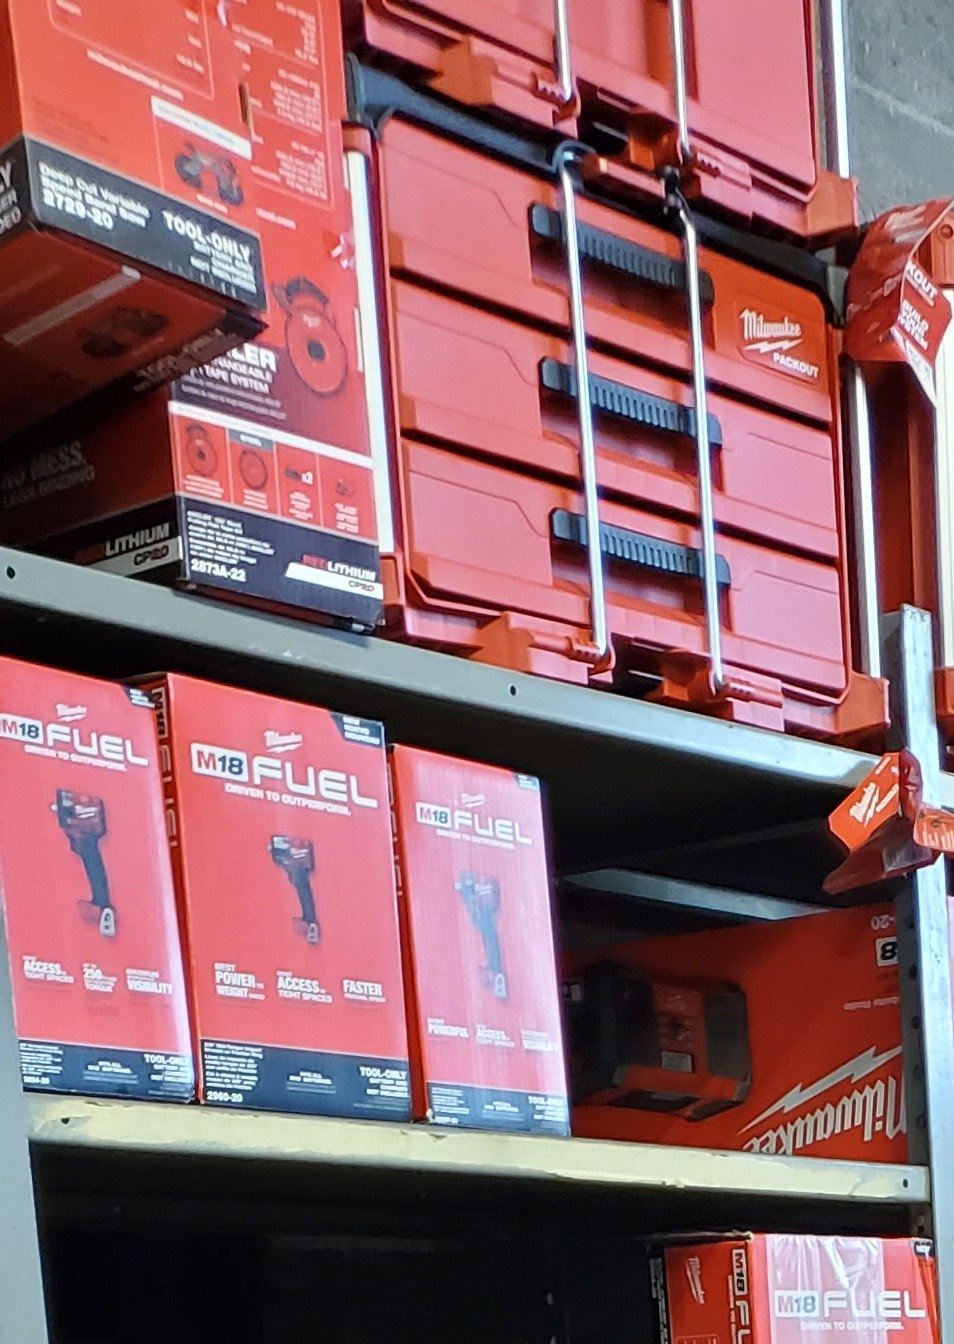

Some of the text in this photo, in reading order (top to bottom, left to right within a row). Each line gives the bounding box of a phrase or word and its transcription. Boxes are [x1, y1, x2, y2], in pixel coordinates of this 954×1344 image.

[38, 160, 74, 188] Deep
[162, 210, 252, 264] TOOL-ONLY
[740, 308, 802, 341] Milwaukee
[773, 352, 820, 379] PACKOUT
[190, 559, 247, 583] 2873A-22
[3, 719, 149, 766] M18 FUEL
[197, 750, 378, 808] M18 FUEL
[224, 782, 280, 802] DRIVEN TO
[419, 807, 532, 845] M18 FUEL
[214, 970, 256, 988] POWER
[277, 975, 320, 993] ACCESS
[342, 979, 383, 997] FASTER
[734, 1252, 745, 1292] M18
[776, 1291, 926, 1319] M18 FUEL
[833, 1321, 846, 1331] TO
